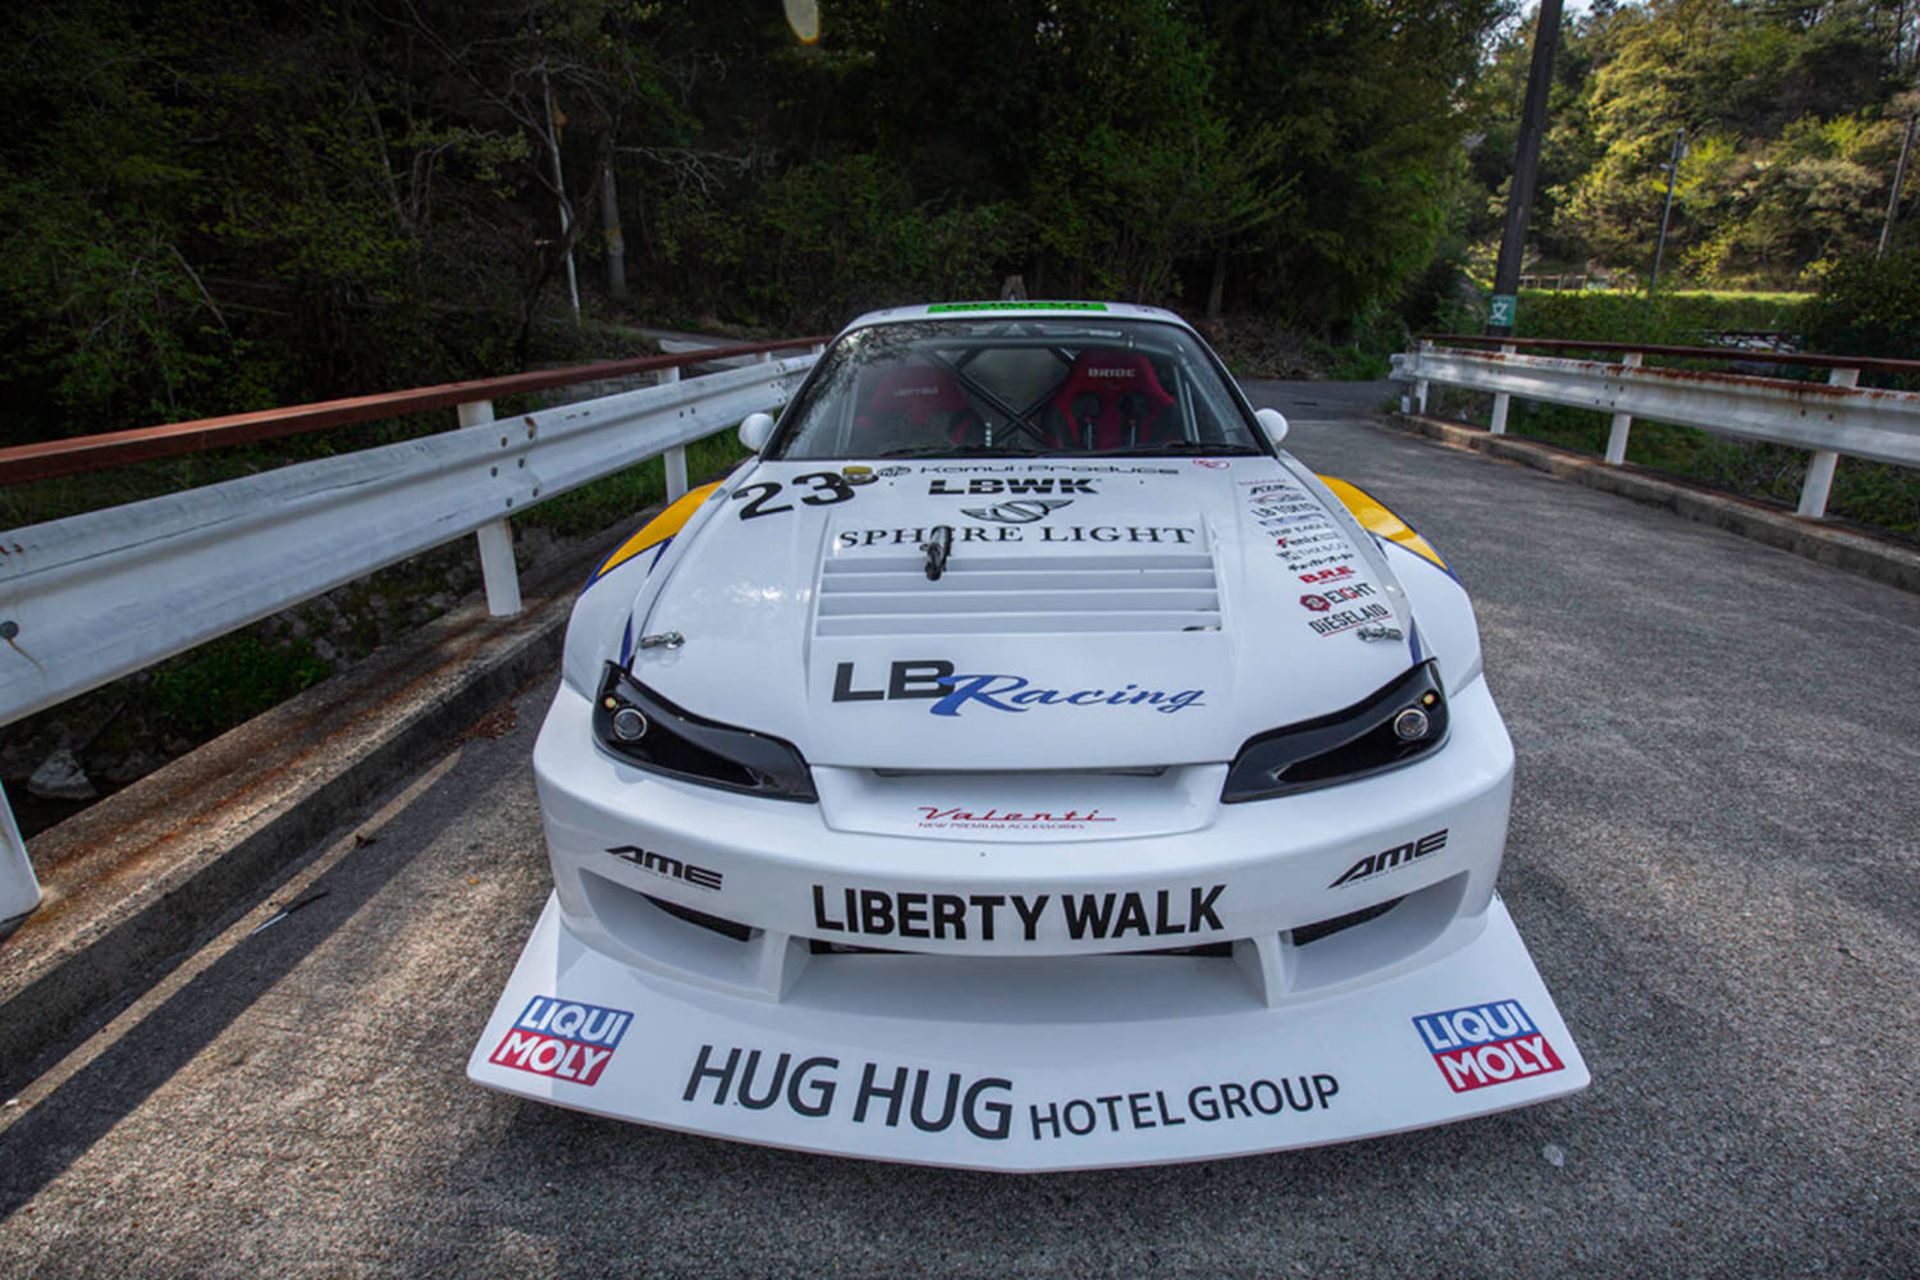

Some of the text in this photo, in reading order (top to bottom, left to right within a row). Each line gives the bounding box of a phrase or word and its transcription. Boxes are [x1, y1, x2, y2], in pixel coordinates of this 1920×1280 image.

[731, 471, 856, 521] 23
[928, 479, 1097, 495] LBWK
[840, 525, 1195, 547] SPHRE LIGHT
[1324, 583, 1376, 604] EIGHT
[832, 660, 1206, 716] LB Racing
[917, 807, 1116, 821] Valenti
[605, 845, 723, 891] AME
[1328, 828, 1449, 890] AME
[813, 884, 1227, 941] LIBERTY WALK
[519, 998, 628, 1046] LIQUI
[1421, 1001, 1536, 1050] LIQUI
[495, 1031, 612, 1083] MOLY
[1440, 1034, 1560, 1091] MOLY
[683, 1046, 1340, 1140] HUG HUG HOTEL GROUP
